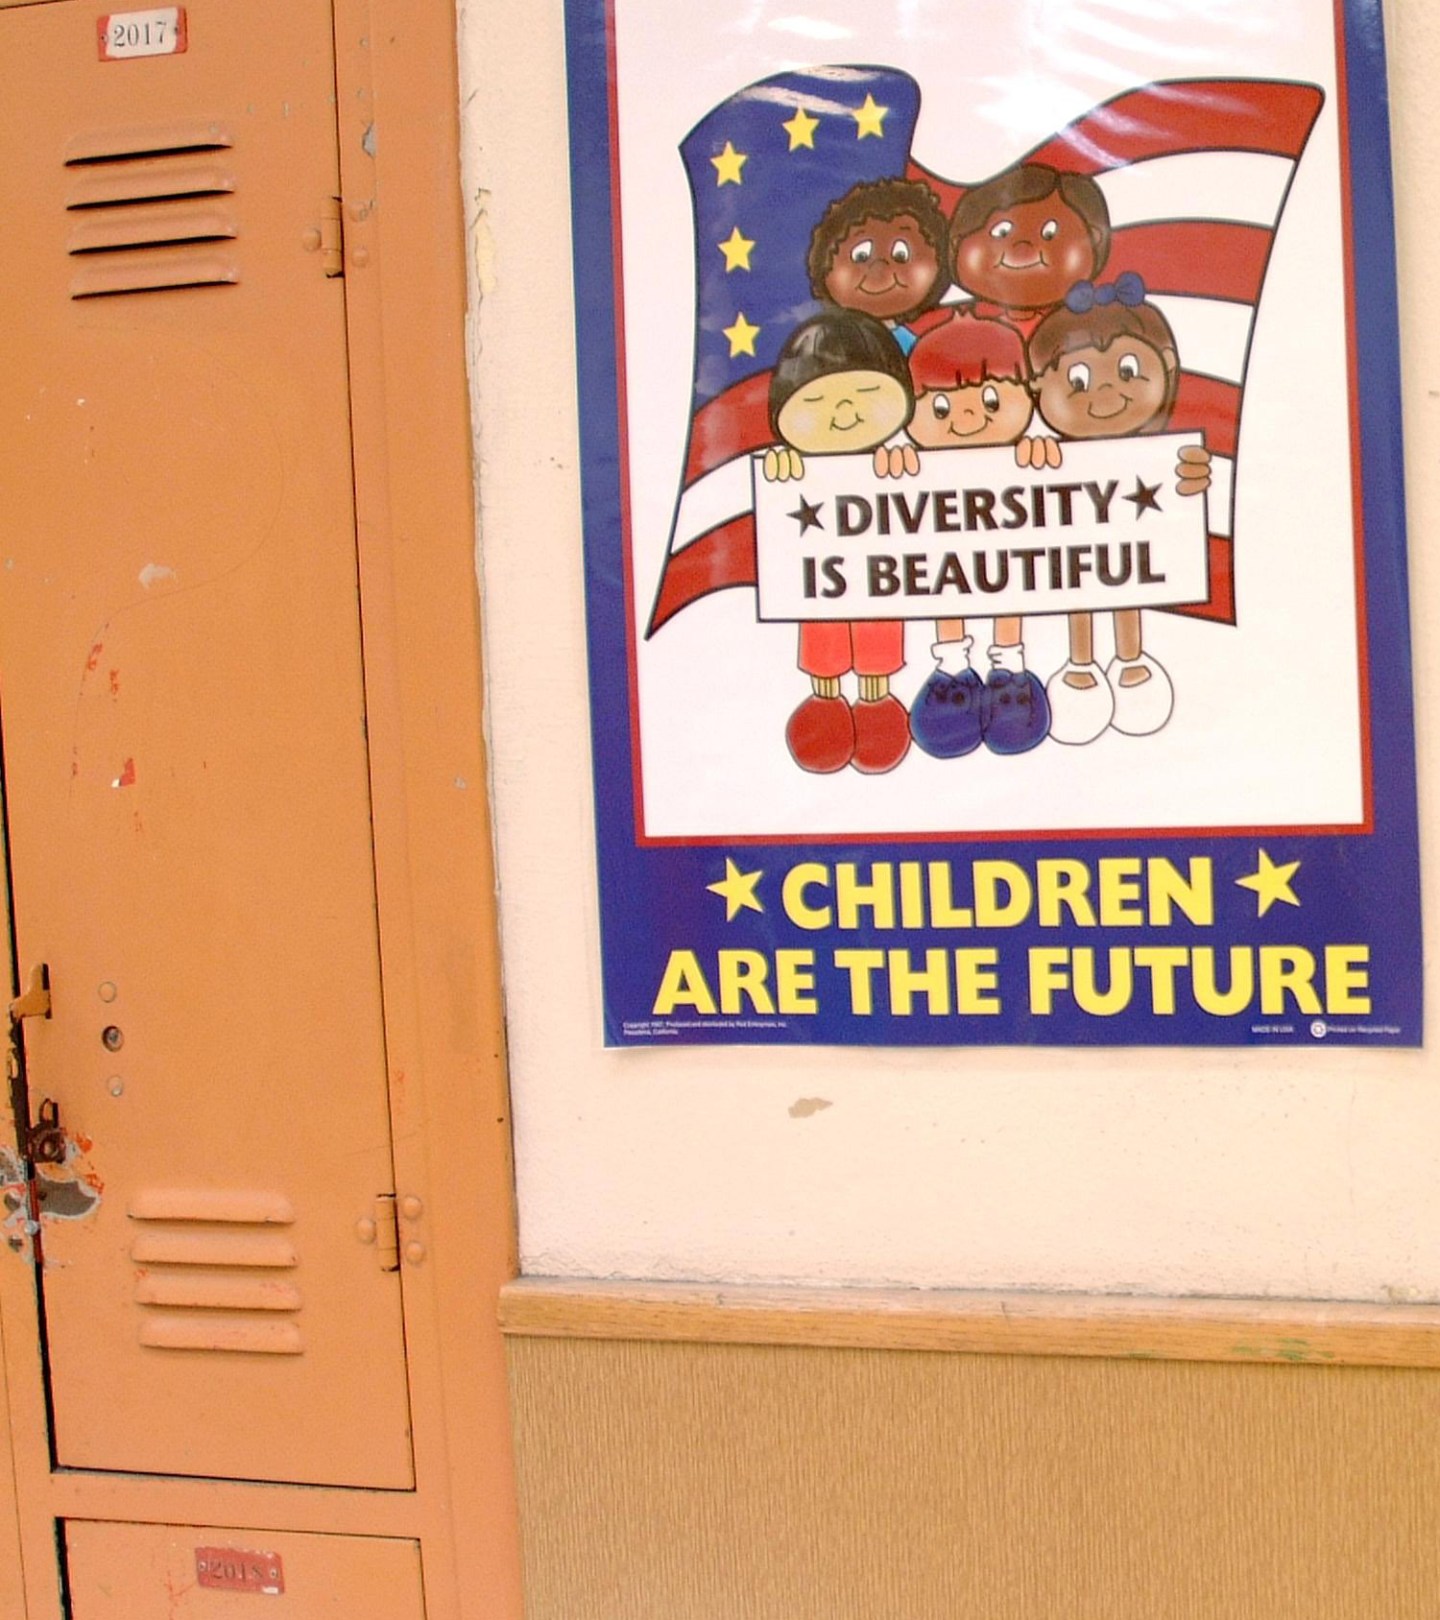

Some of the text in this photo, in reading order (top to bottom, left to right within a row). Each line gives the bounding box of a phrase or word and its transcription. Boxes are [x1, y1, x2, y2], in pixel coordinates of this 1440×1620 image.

[113, 20, 167, 47] 2017
[835, 479, 1120, 537] DIVERSITY
[803, 540, 1166, 599] IS BEAUTIFUL
[781, 856, 1214, 930] CHILDREN
[653, 945, 1371, 1016] ARE THE FUTURE
